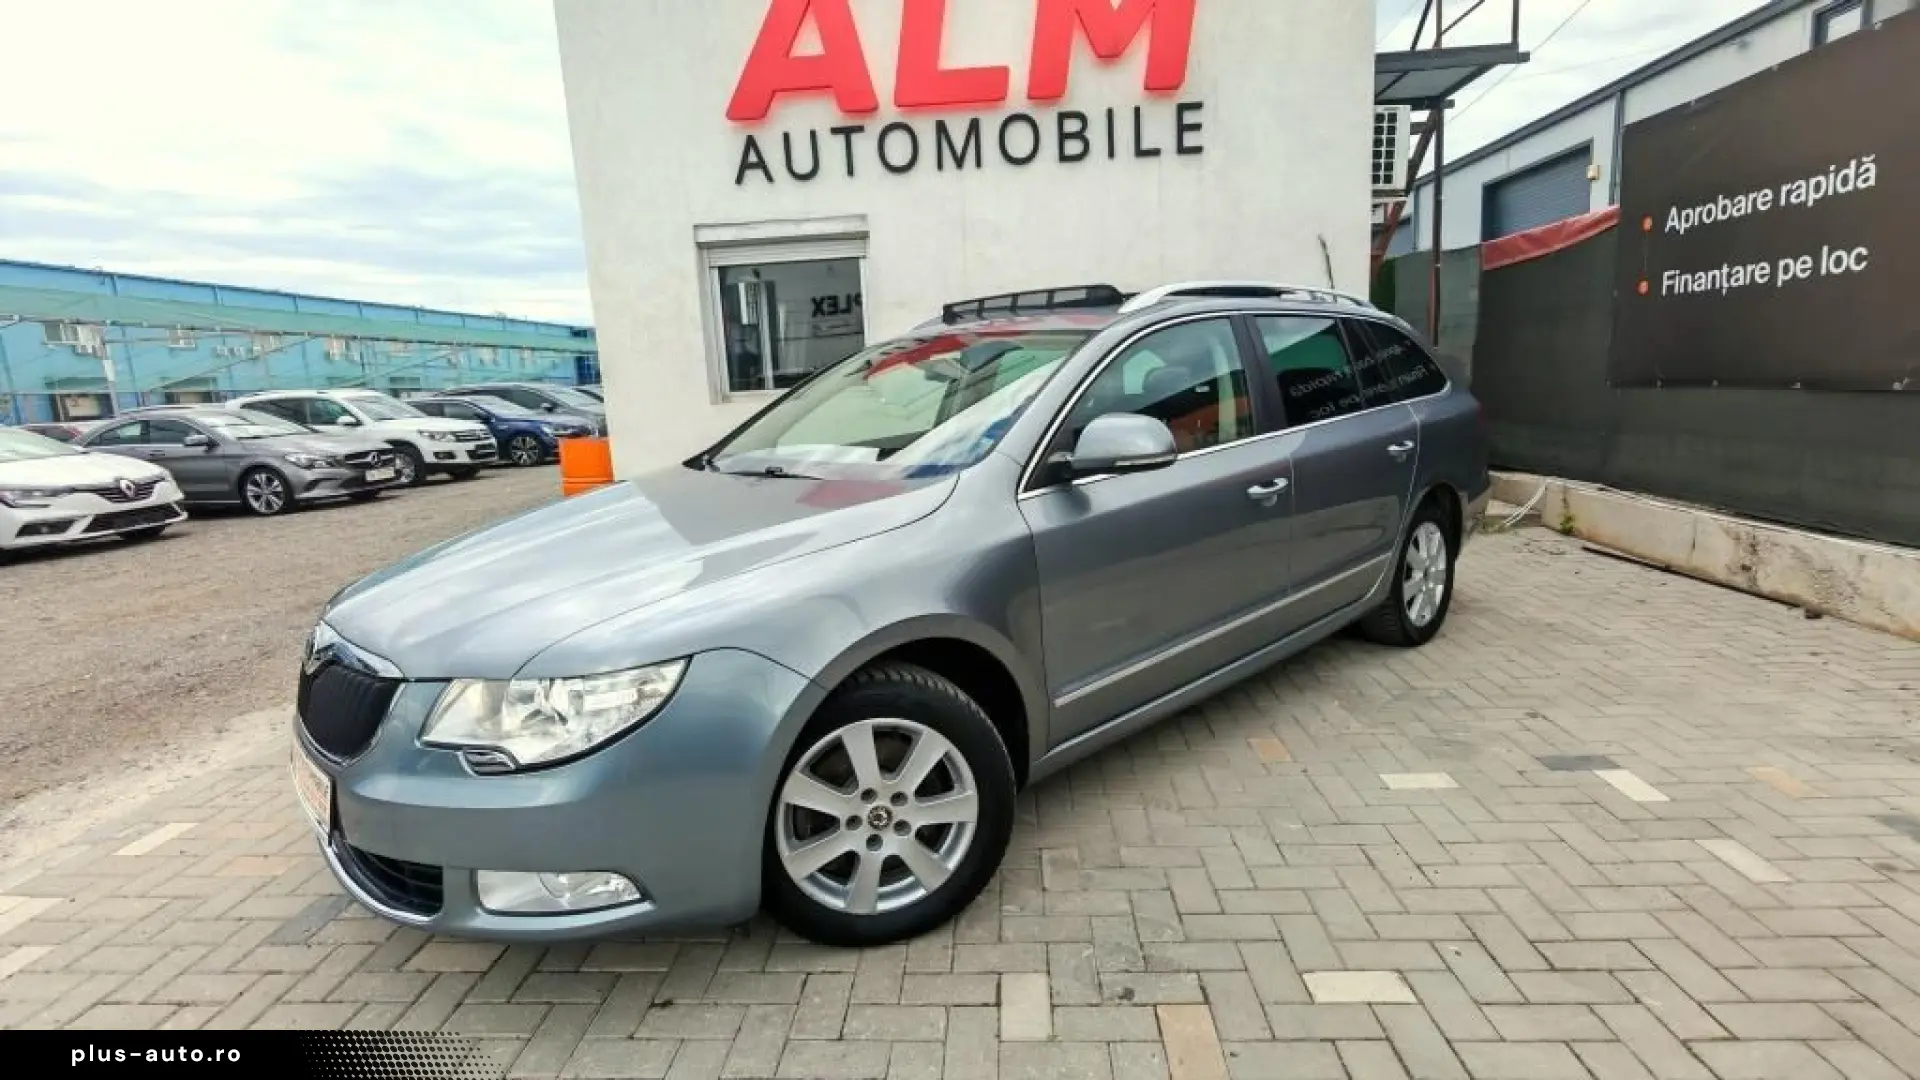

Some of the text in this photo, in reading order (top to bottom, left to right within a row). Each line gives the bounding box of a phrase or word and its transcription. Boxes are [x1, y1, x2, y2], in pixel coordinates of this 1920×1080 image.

[727, 0, 1197, 124] ALM
[734, 101, 1204, 185] AUTOMOBILE
[1664, 153, 1877, 235] Aprobare rapidă
[1662, 244, 1869, 296] Finanțare pe loc
